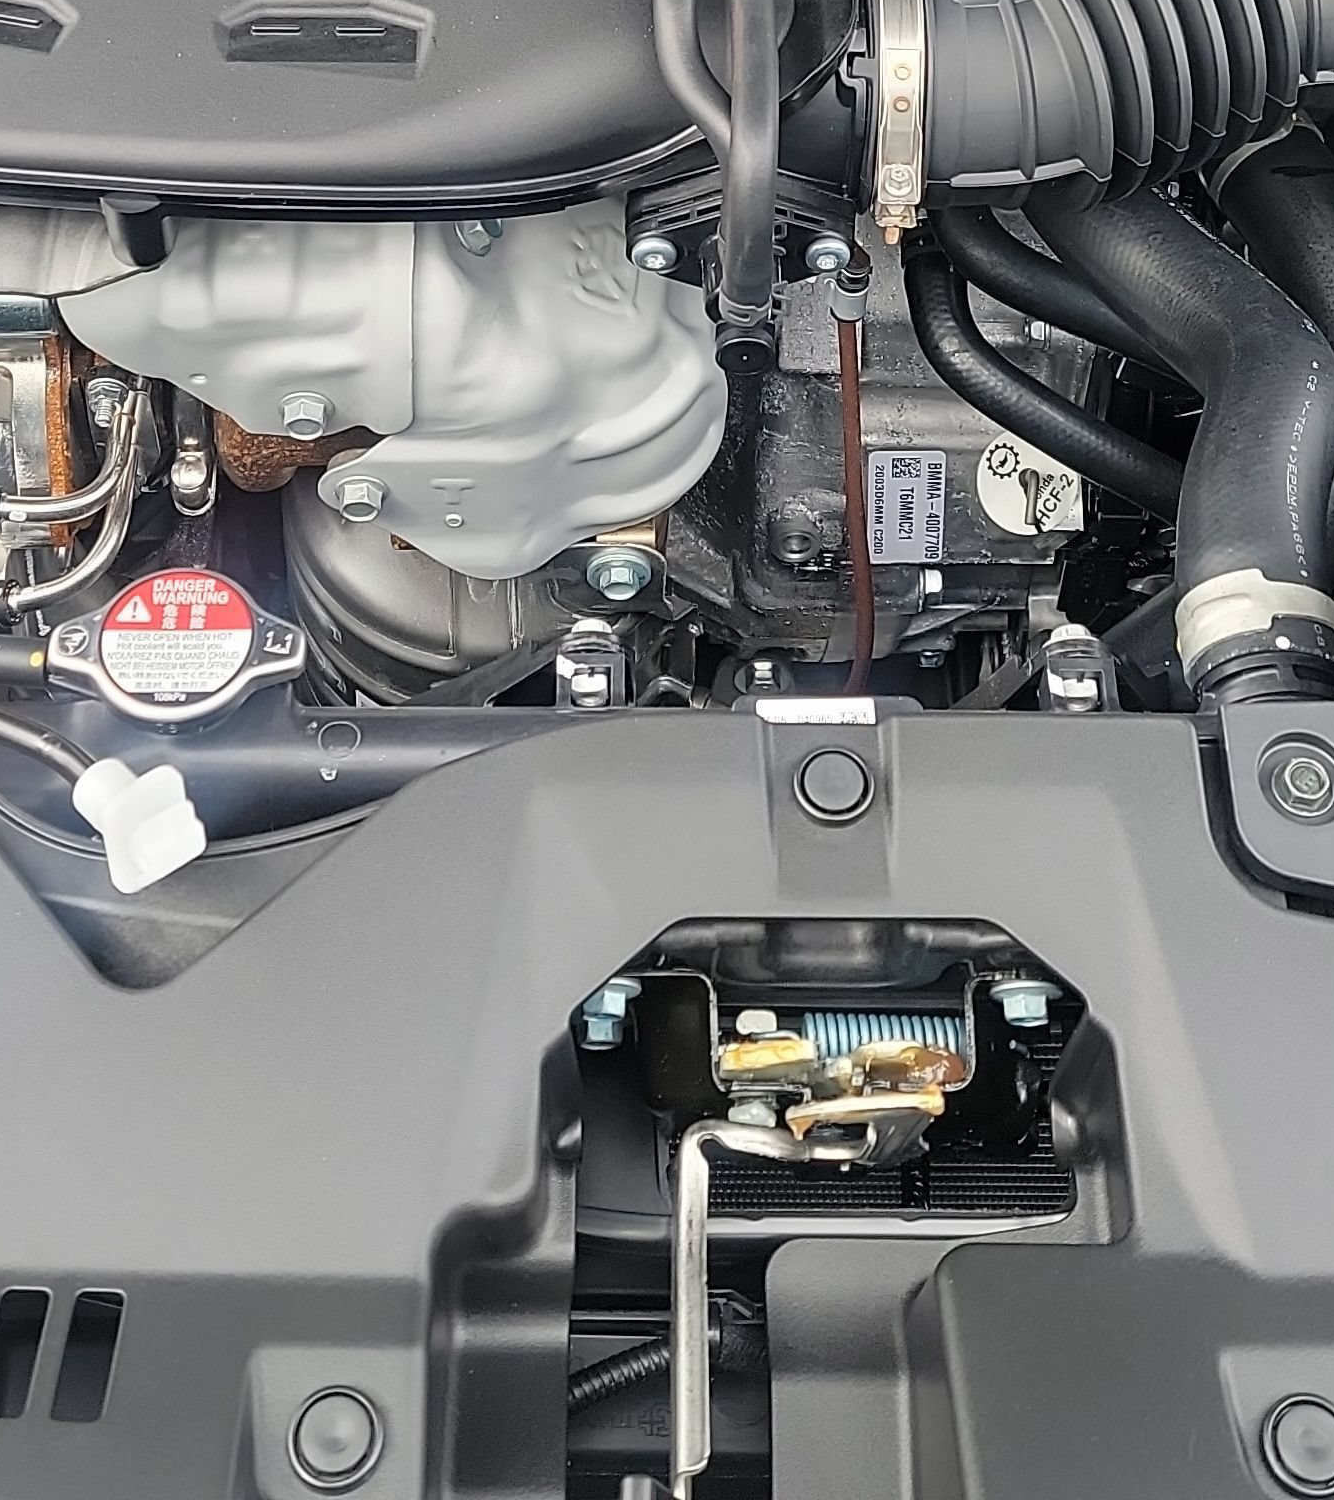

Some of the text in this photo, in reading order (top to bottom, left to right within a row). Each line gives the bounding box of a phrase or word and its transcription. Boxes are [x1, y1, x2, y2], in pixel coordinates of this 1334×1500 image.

[1034, 473, 1075, 528] HCF-2
[898, 486, 915, 542] T6MMC21
[924, 462, 943, 559] BMMA-4007709
[153, 578, 215, 592] DANGER
[152, 591, 230, 605] WARNUNG
[118, 633, 235, 641] NEVER OPEN WHEN HOT.
[117, 642, 223, 652] Hot coolant will scald you.
[107, 652, 153, 661] N'OUVREZ
[154, 652, 173, 660] PAS
[174, 652, 205, 661] QUAND
[111, 662, 136, 670] NICHT
